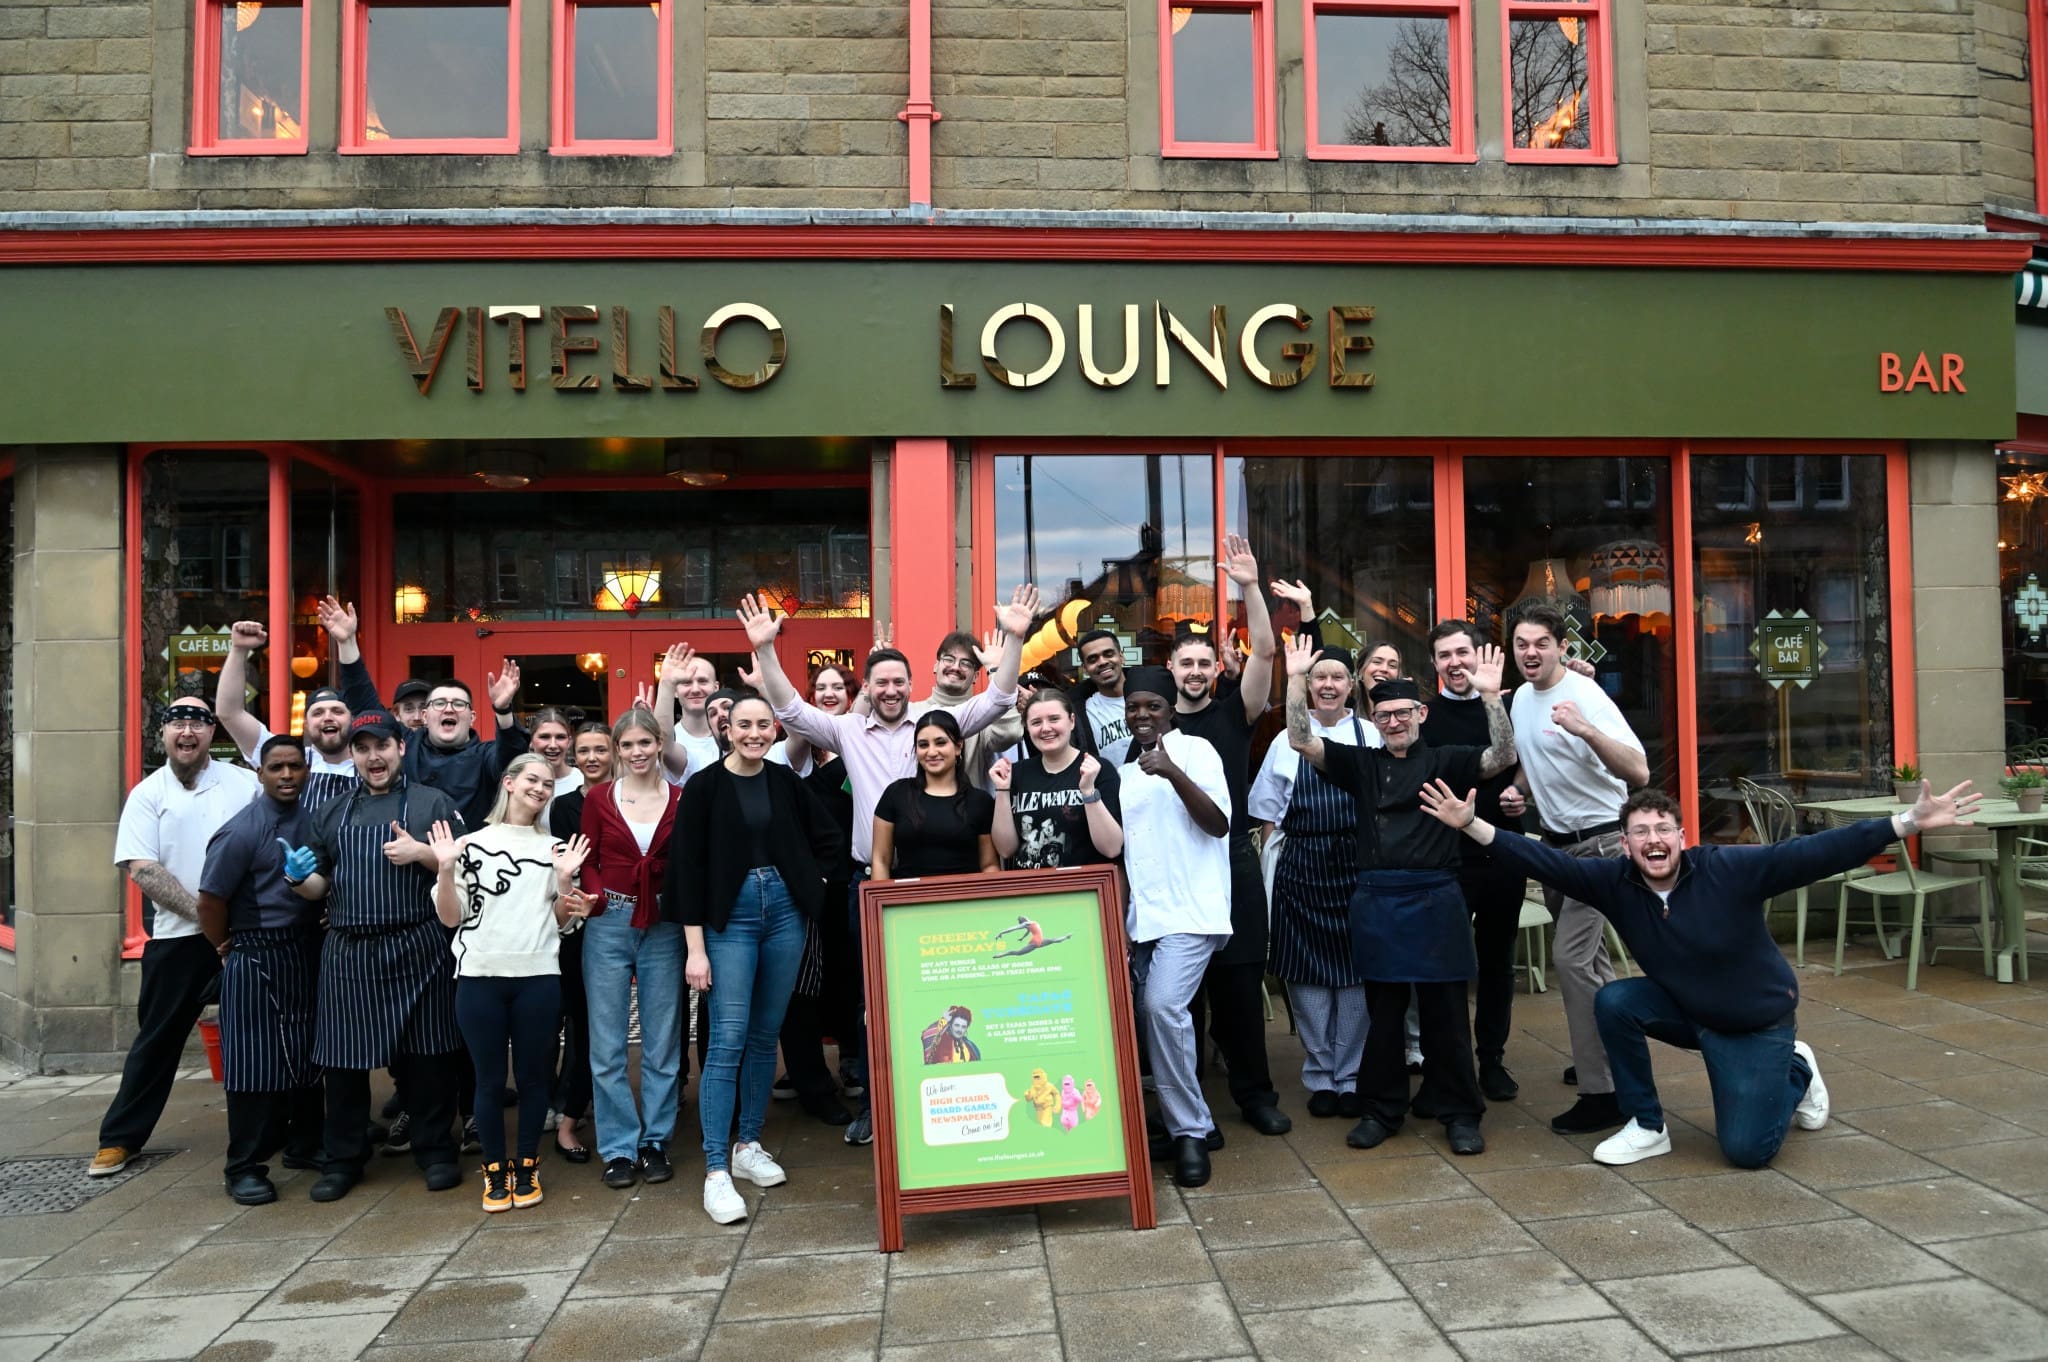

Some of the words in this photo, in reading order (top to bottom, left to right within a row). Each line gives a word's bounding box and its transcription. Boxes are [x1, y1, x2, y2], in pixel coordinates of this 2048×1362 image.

[383, 302, 788, 397] VITELLO
[940, 300, 1377, 391] LOUNGE
[1880, 351, 1968, 393] BAR
[178, 636, 209, 652] CAFÉ
[1774, 634, 1803, 649] CAFÉ
[1778, 651, 1800, 663] BAR
[1041, 789, 1085, 809] WAVES
[919, 930, 991, 945] CHEEKY
[925, 1085, 938, 1097] We
[929, 1097, 953, 1106] HIGH
[955, 1094, 990, 1104] CHAIRS
[930, 1105, 962, 1115] BOARD
[963, 1103, 997, 1113] GAMES
[931, 1112, 993, 1125] NEWSPAPERS
